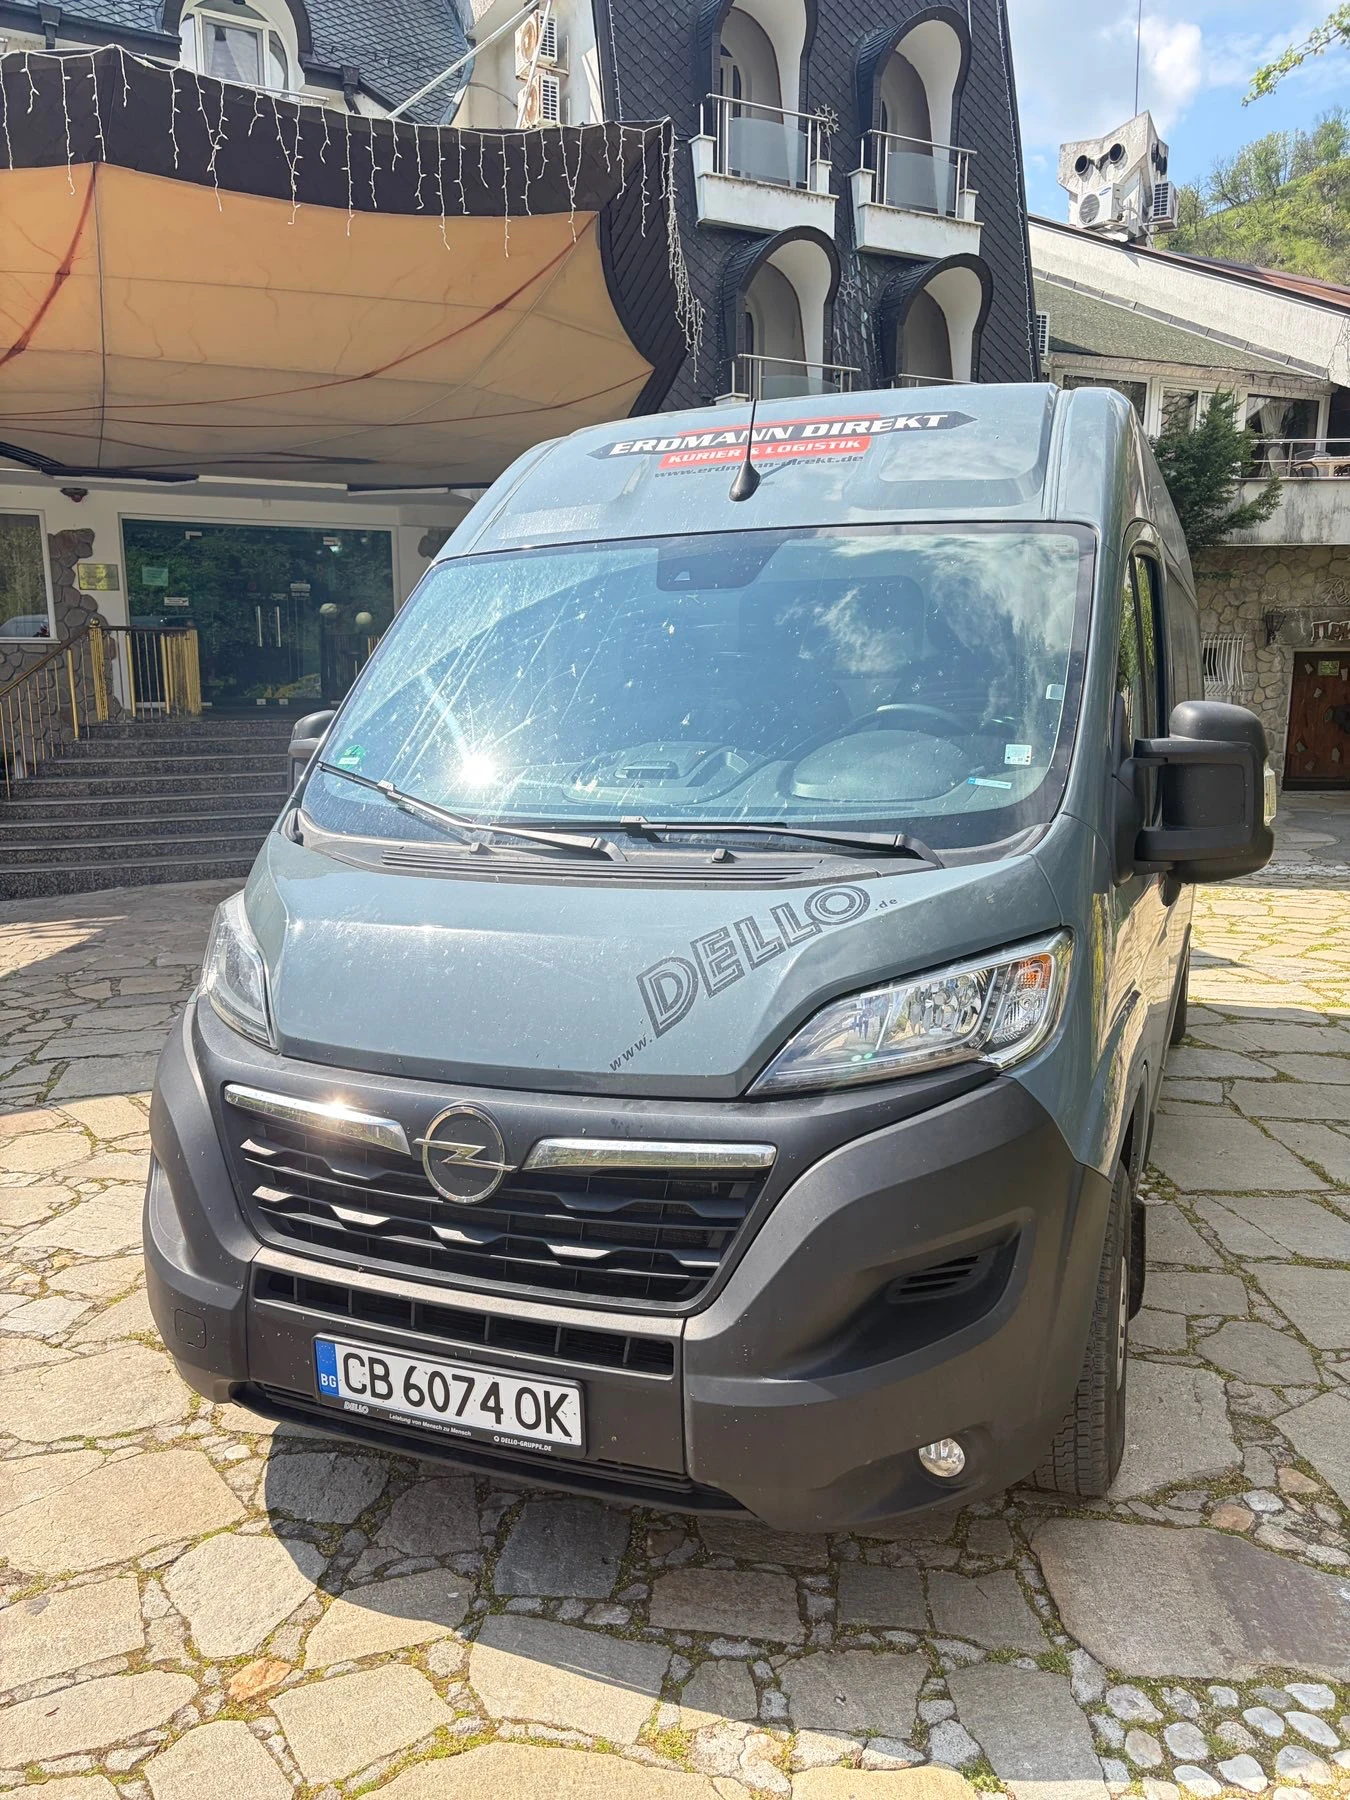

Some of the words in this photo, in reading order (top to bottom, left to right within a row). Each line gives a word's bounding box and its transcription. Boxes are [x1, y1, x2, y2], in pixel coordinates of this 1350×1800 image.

[609, 426, 794, 456] ERDMANN
[800, 414, 949, 438] DIREKT
[668, 449, 742, 464] KURIER
[765, 439, 862, 455] LOGISTIK
[320, 1372, 338, 1389] BG
[343, 1352, 394, 1401] CB
[403, 1365, 504, 1425] 6074
[514, 1386, 573, 1438] OK
[343, 1400, 370, 1415] DELLO
[411, 1419, 422, 1427] von
[422, 1420, 443, 1431] Mensch
[450, 1427, 472, 1438] Mensch
[500, 1436, 552, 1452] DELLO-GRUPPE.DE
